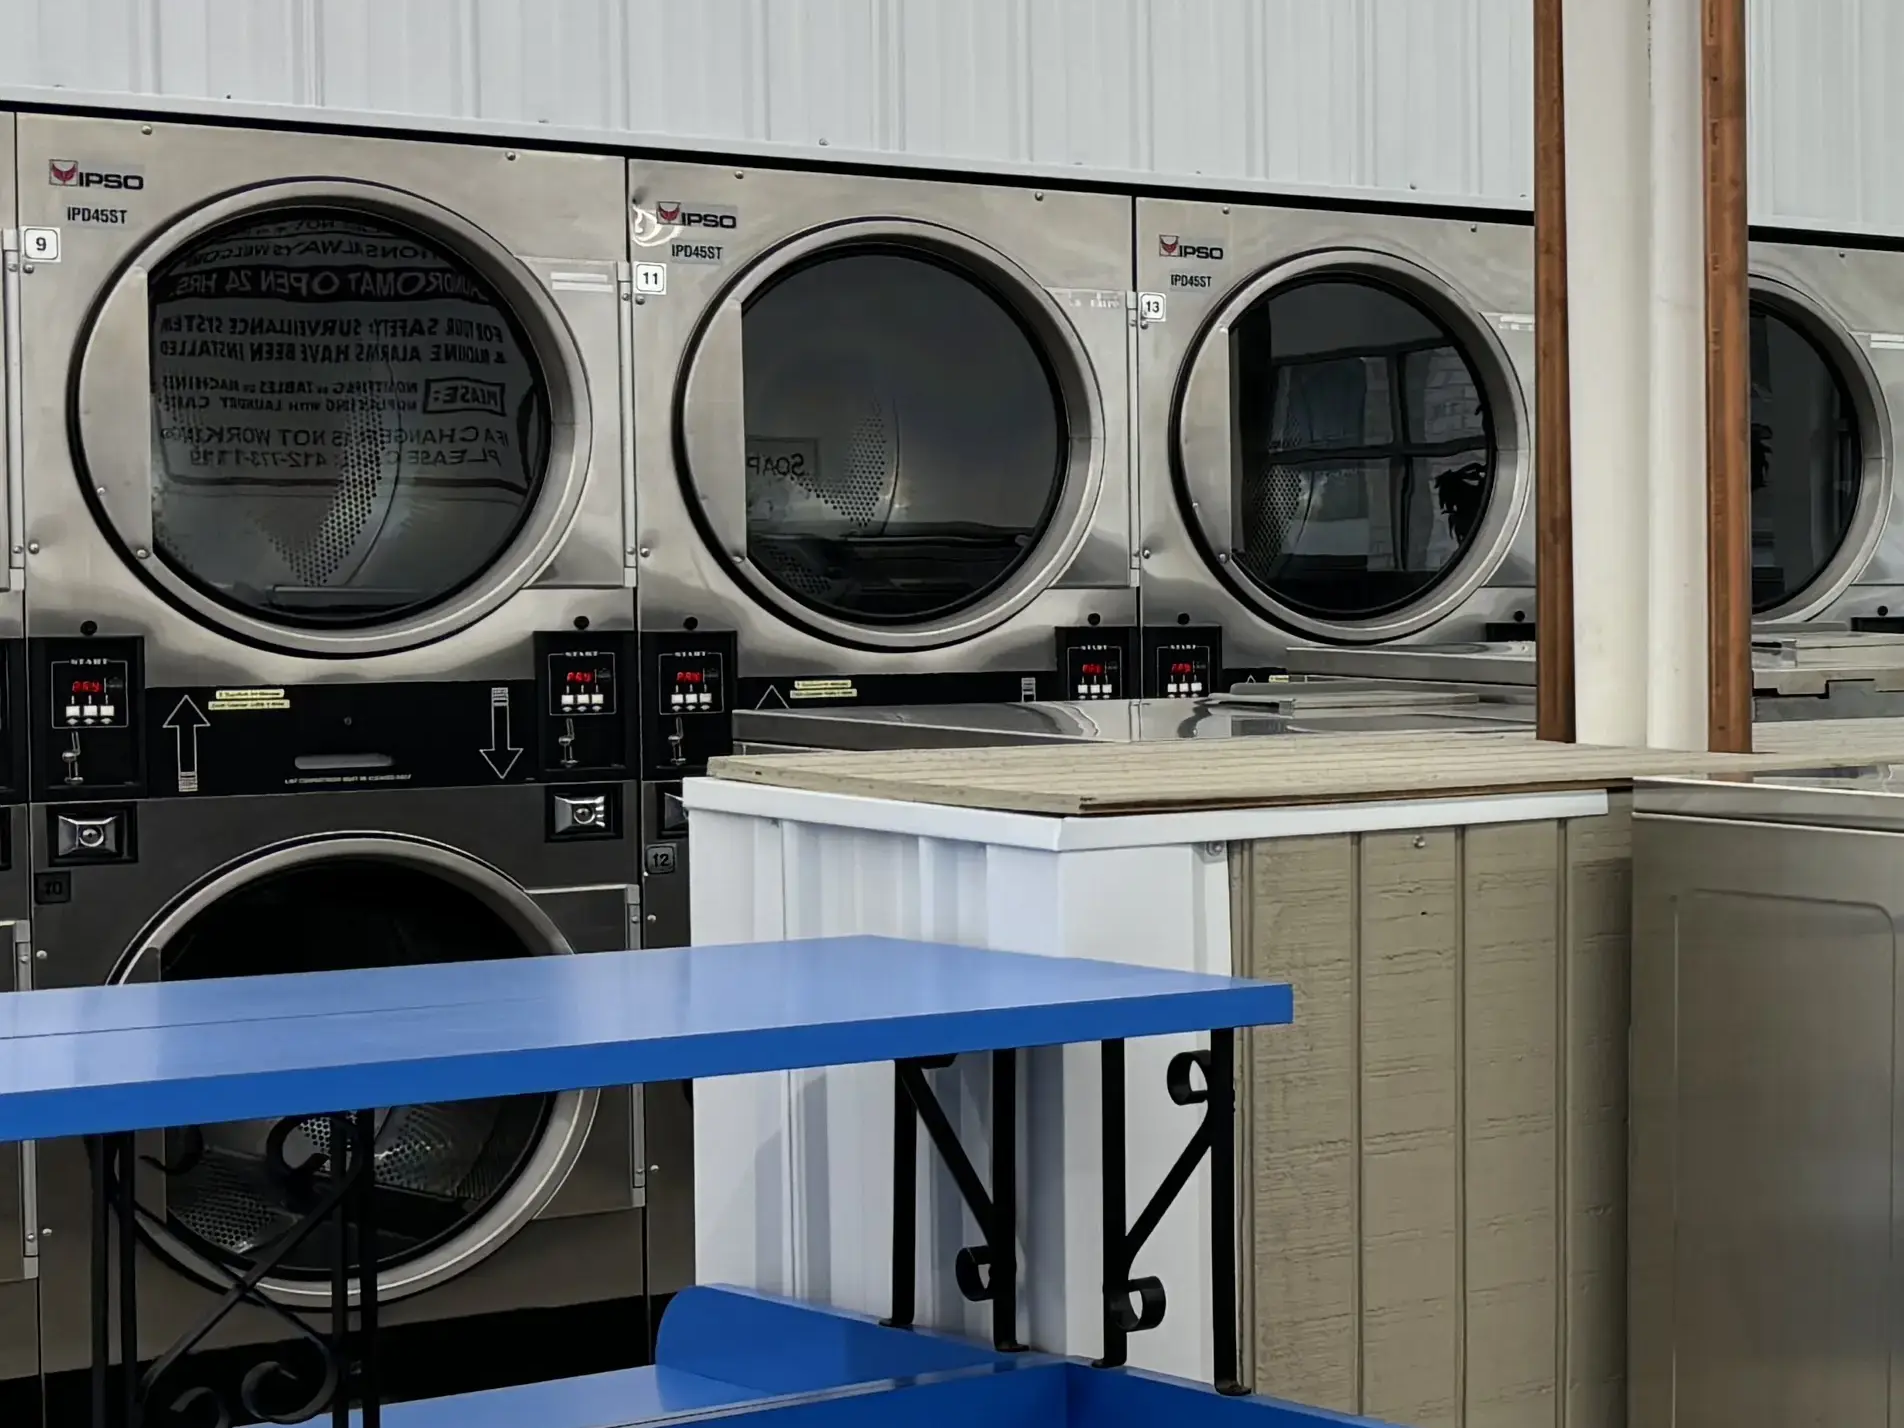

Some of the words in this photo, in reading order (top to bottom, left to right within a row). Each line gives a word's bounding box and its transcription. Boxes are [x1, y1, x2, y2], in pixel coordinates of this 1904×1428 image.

[79, 171, 144, 190] IPSO
[67, 206, 128, 224] IPD45ST
[682, 212, 737, 229] IPSO
[35, 237, 47, 251] 9
[671, 244, 723, 260] IPD45ST
[1179, 245, 1223, 260] IPSO
[643, 272, 658, 285] 11
[1146, 300, 1160, 313] 13
[72, 680, 101, 693] PAY
[653, 852, 669, 868] 12
